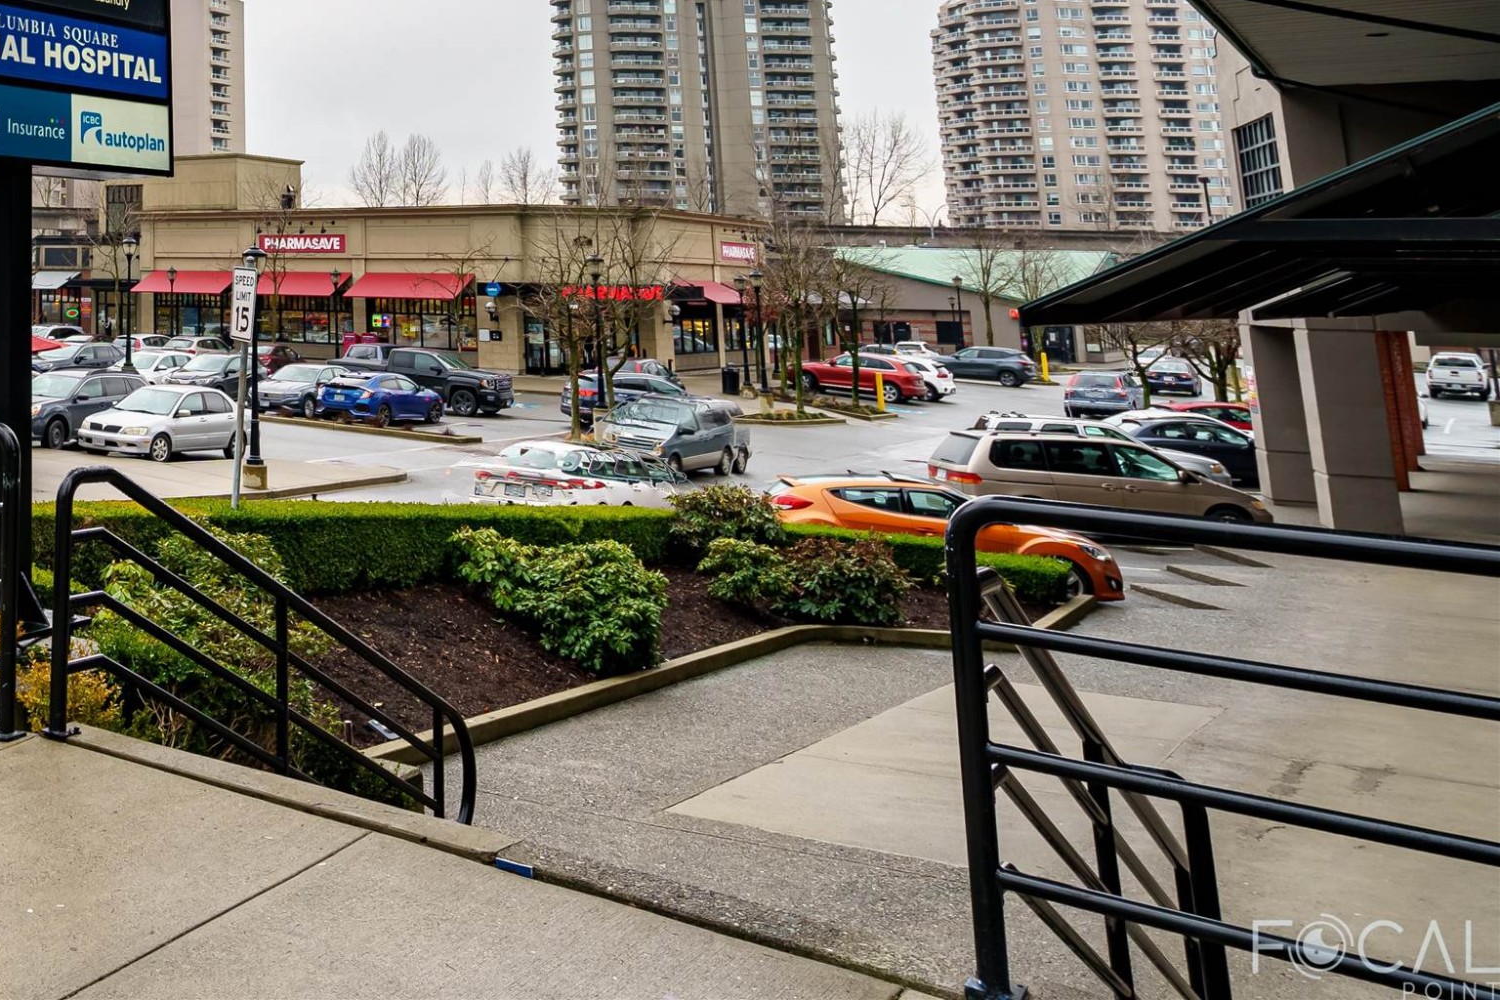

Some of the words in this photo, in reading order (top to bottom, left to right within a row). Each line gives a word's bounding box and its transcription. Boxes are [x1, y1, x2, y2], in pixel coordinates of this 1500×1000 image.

[63, 25, 119, 48] SQUARE
[44, 40, 162, 84] HOSPITAL
[7, 118, 65, 140] Insurance
[82, 115, 100, 125] ICBC
[105, 131, 165, 153] autoplan
[264, 237, 340, 250] PHARMASAVE
[235, 275, 254, 287] SPEED
[235, 292, 251, 302] LIMIT
[236, 305, 249, 332] 15
